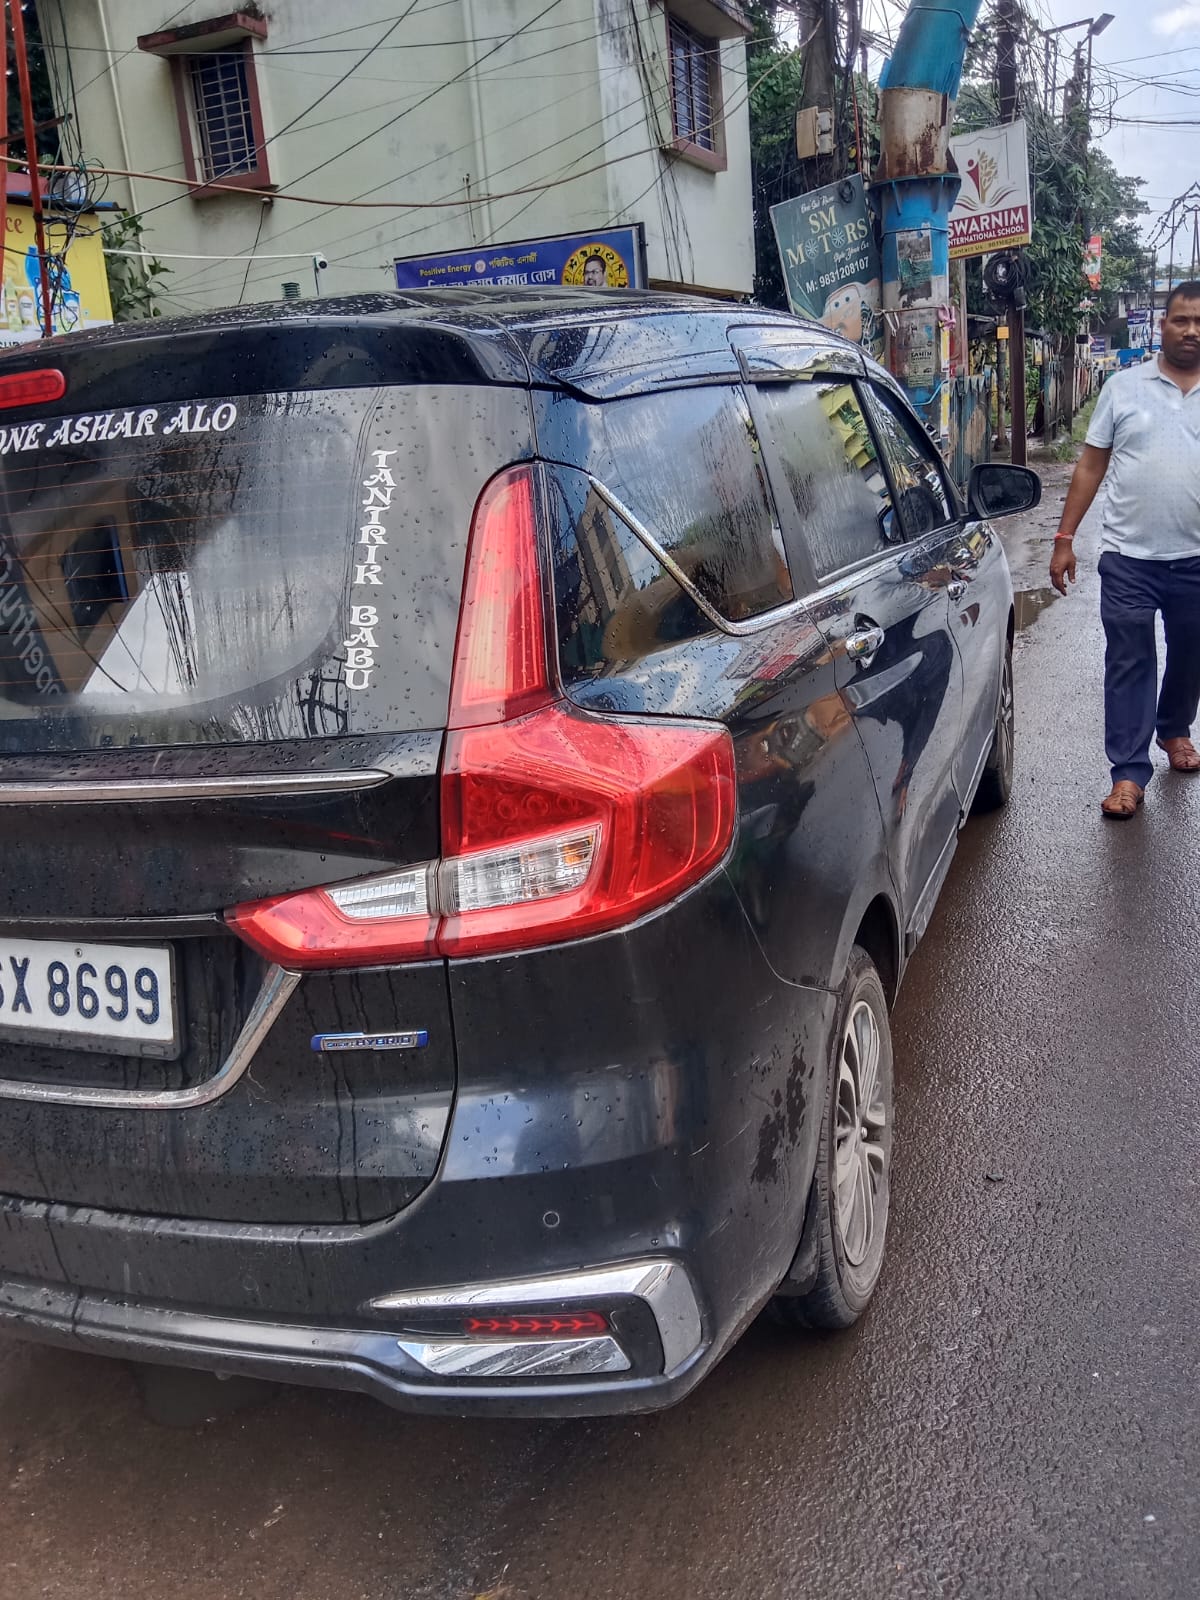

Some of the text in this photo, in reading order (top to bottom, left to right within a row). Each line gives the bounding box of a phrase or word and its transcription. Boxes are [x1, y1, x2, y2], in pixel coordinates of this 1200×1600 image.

[809, 205, 837, 234] SM
[948, 208, 1024, 237] SWARNIM
[948, 226, 1025, 246] NTERNATIONAL SCHOOL
[786, 218, 867, 269] MOTORS
[420, 266, 446, 277] Positive
[447, 264, 472, 273] Energy
[46, 408, 156, 448] ASHAR
[163, 403, 238, 435] ALO
[354, 449, 398, 585] TANTRIK
[343, 605, 379, 690] BABU
[0, 956, 160, 1025] X 8699
[356, 1036, 411, 1047] HYBRID
